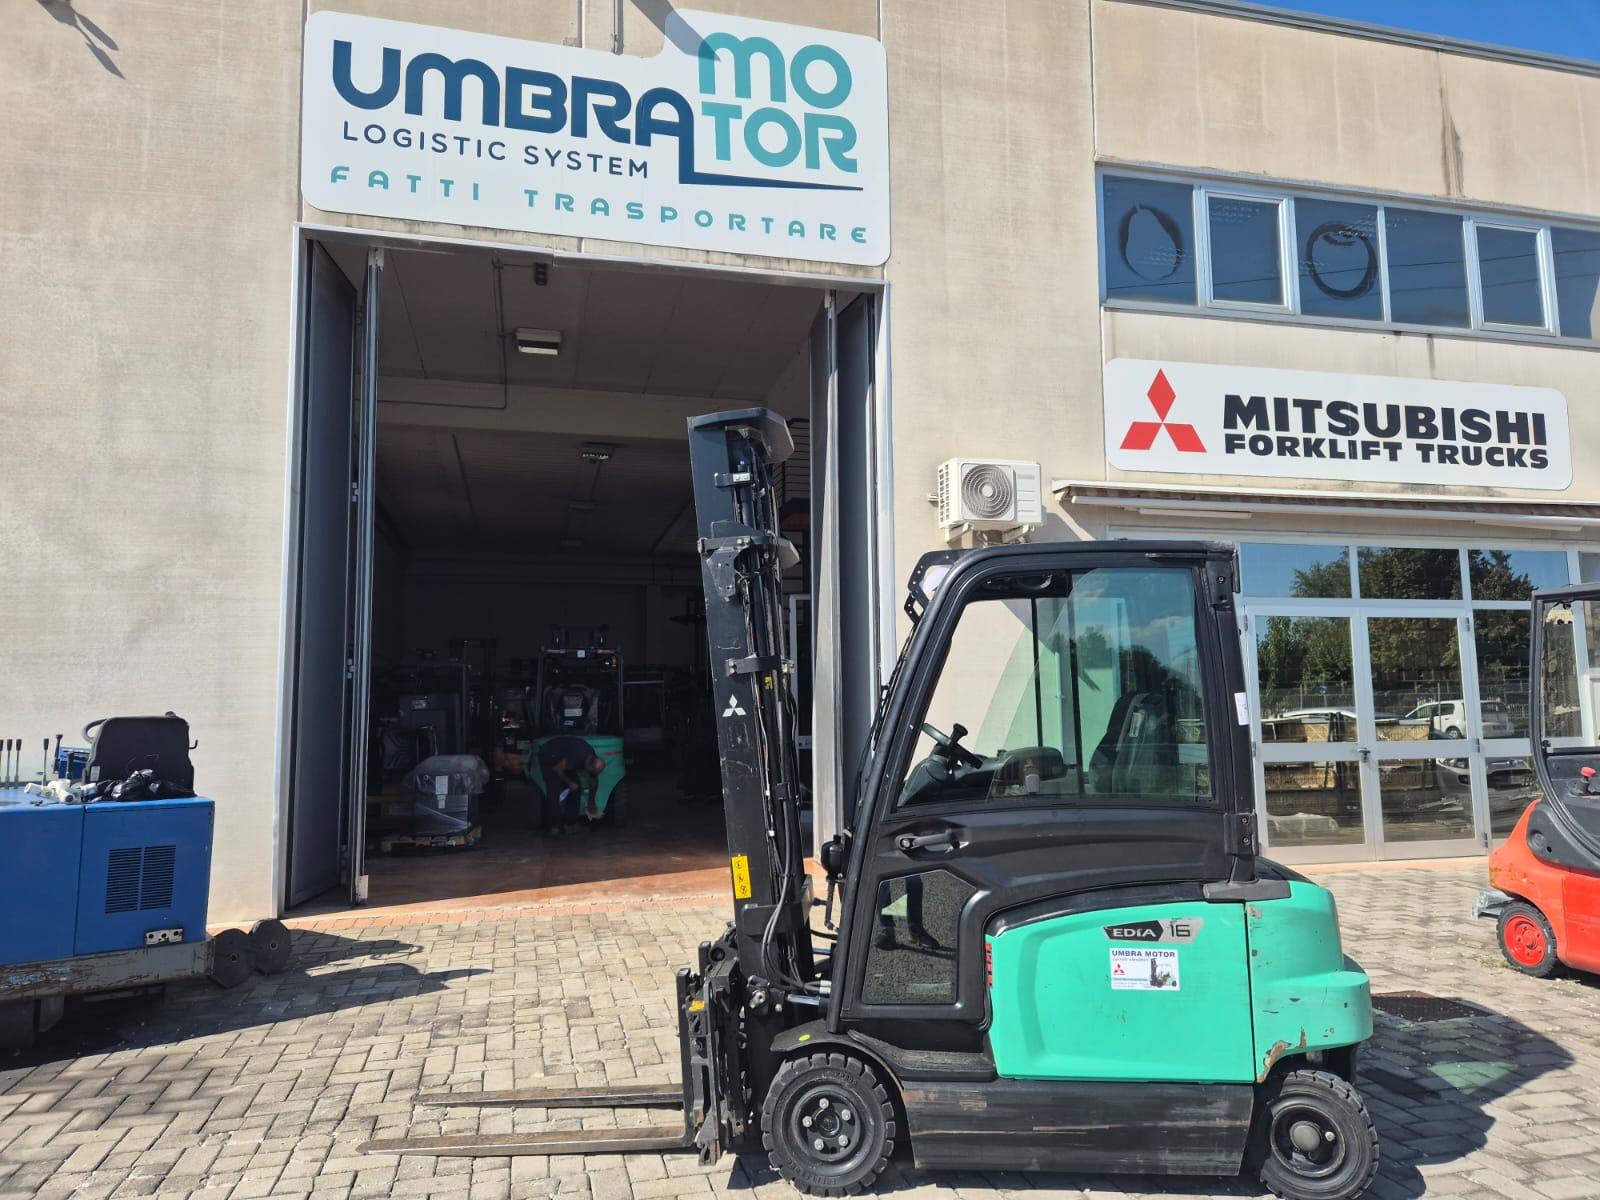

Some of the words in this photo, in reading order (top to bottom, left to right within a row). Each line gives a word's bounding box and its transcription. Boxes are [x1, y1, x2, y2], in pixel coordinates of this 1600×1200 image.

[332, 40, 695, 152] UMBRA
[699, 31, 853, 109] MO
[342, 120, 507, 162] LOGISTIC
[523, 145, 648, 180] SYSTEM
[700, 101, 858, 174] TOR
[330, 165, 480, 201] FATTI
[523, 188, 868, 245] TRASPORTARE
[1223, 394, 1547, 446] MITSUBISHI
[1224, 433, 1402, 463] FORKLIFT
[1416, 443, 1549, 470] TRUCKS
[1170, 924, 1191, 937] 16
